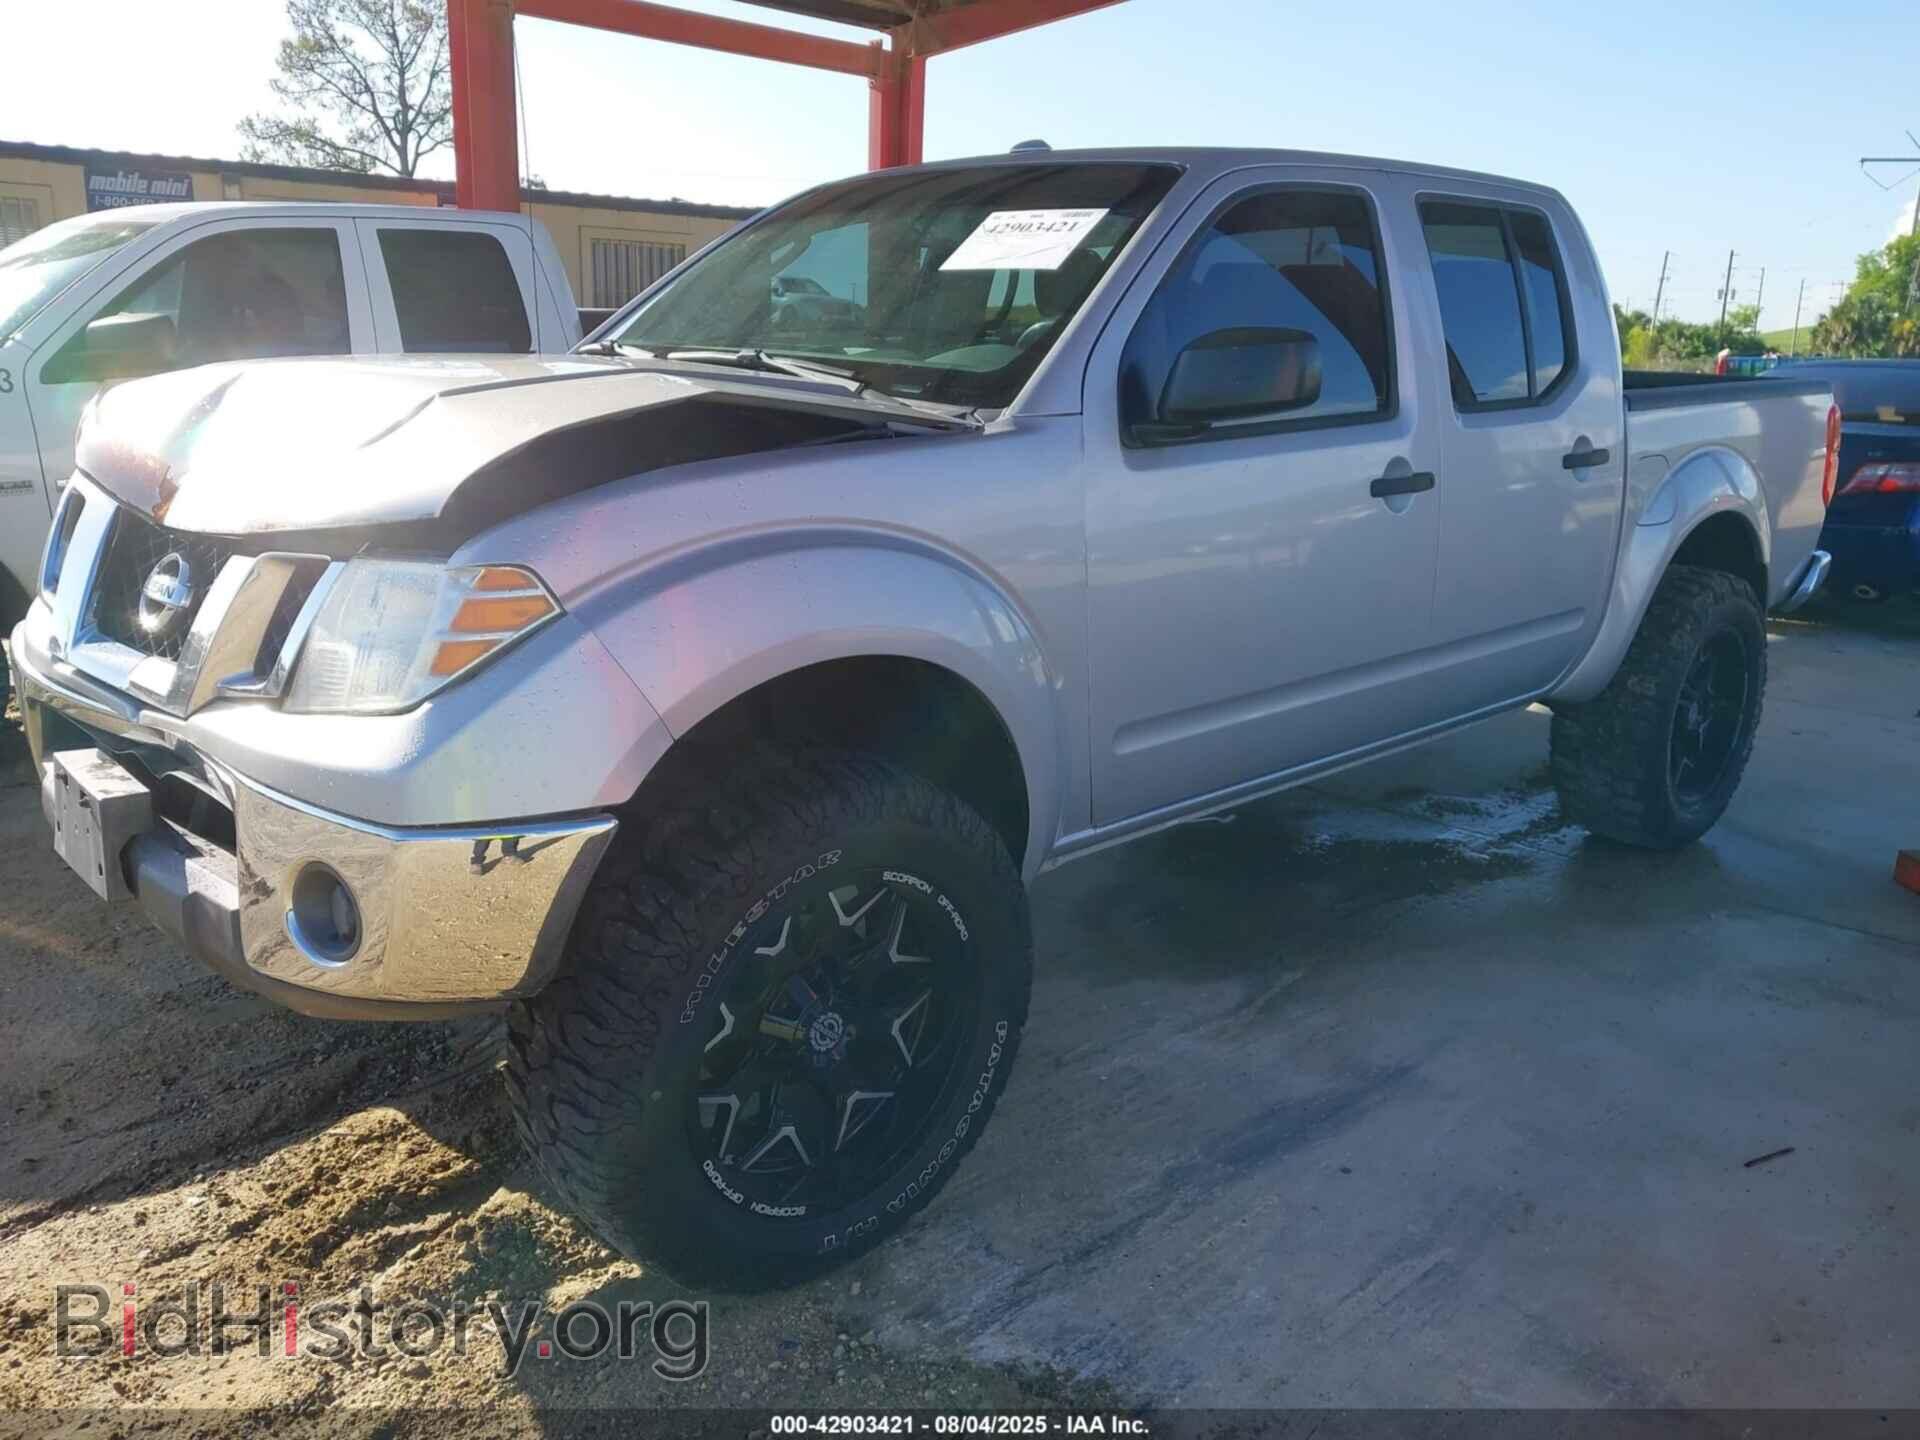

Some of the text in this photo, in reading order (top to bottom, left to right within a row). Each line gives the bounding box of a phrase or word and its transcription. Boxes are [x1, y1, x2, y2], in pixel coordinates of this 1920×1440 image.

[89, 170, 189, 197] mobile mini
[988, 220, 1081, 235] 42903421
[680, 849, 842, 1024] MILESTAR
[882, 871, 969, 942] SCORPION OFF-ROAD
[886, 1020, 1008, 1214] PATAGONIA
[703, 1159, 807, 1217] SCORPION OFF-ROAD
